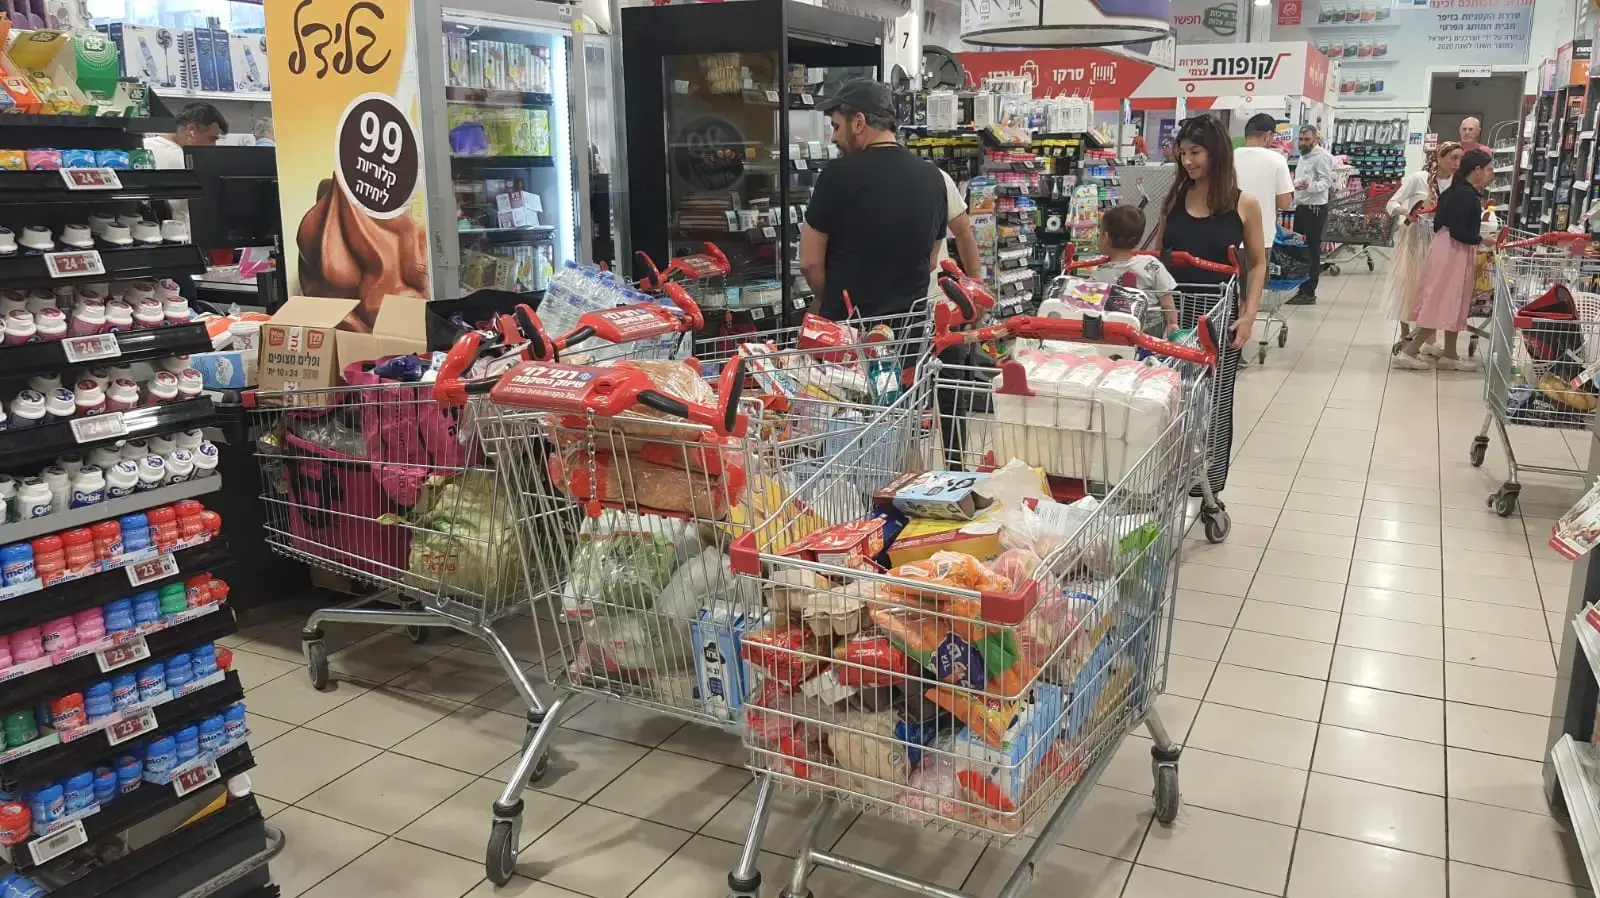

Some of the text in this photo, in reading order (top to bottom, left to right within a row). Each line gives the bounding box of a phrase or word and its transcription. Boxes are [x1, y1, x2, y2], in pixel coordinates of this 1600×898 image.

[903, 32, 910, 49] 7
[1179, 58, 1209, 67] בשירות
[1211, 56, 1274, 80] קופות
[1052, 68, 1085, 84] סרקו
[1188, 69, 1209, 77] עצמי
[360, 111, 403, 164] 99
[356, 156, 397, 188] קלוריות
[356, 179, 390, 206] ליחידה
[268, 352, 321, 367] ופלים מצופים
[522, 366, 579, 380] רמי לוי
[511, 375, 587, 388] שיווק השקמה
[75, 492, 101, 502] Orbit
